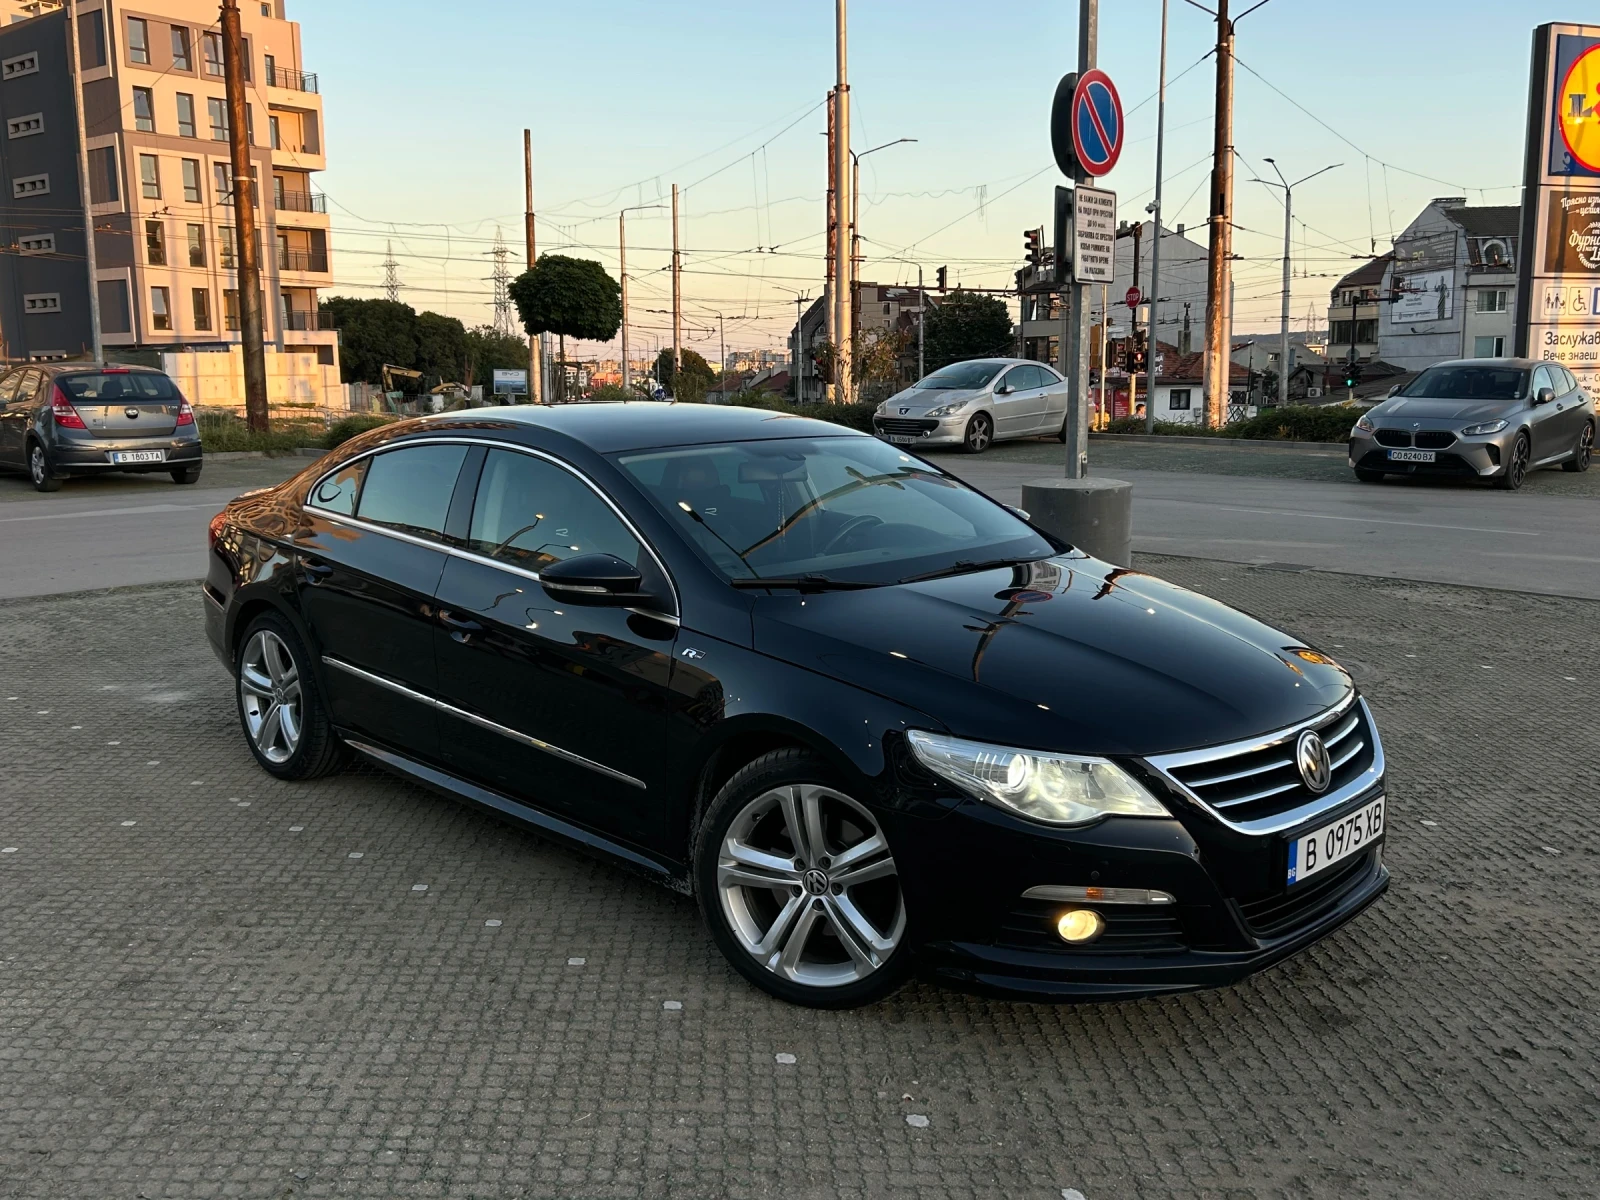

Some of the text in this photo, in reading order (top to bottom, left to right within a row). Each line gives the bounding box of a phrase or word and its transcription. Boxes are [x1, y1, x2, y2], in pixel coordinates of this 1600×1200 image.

[1079, 194, 1112, 207] НЕ ВАЖИ ЗА КЛИЕНТИ
[1127, 293, 1139, 302] STOP
[1543, 349, 1598, 361] Вече знаеш
[122, 452, 160, 462] B 1803 TA
[1403, 452, 1422, 461] 8240
[1306, 802, 1382, 872] B 0975 XB
[1287, 867, 1296, 880] BG
